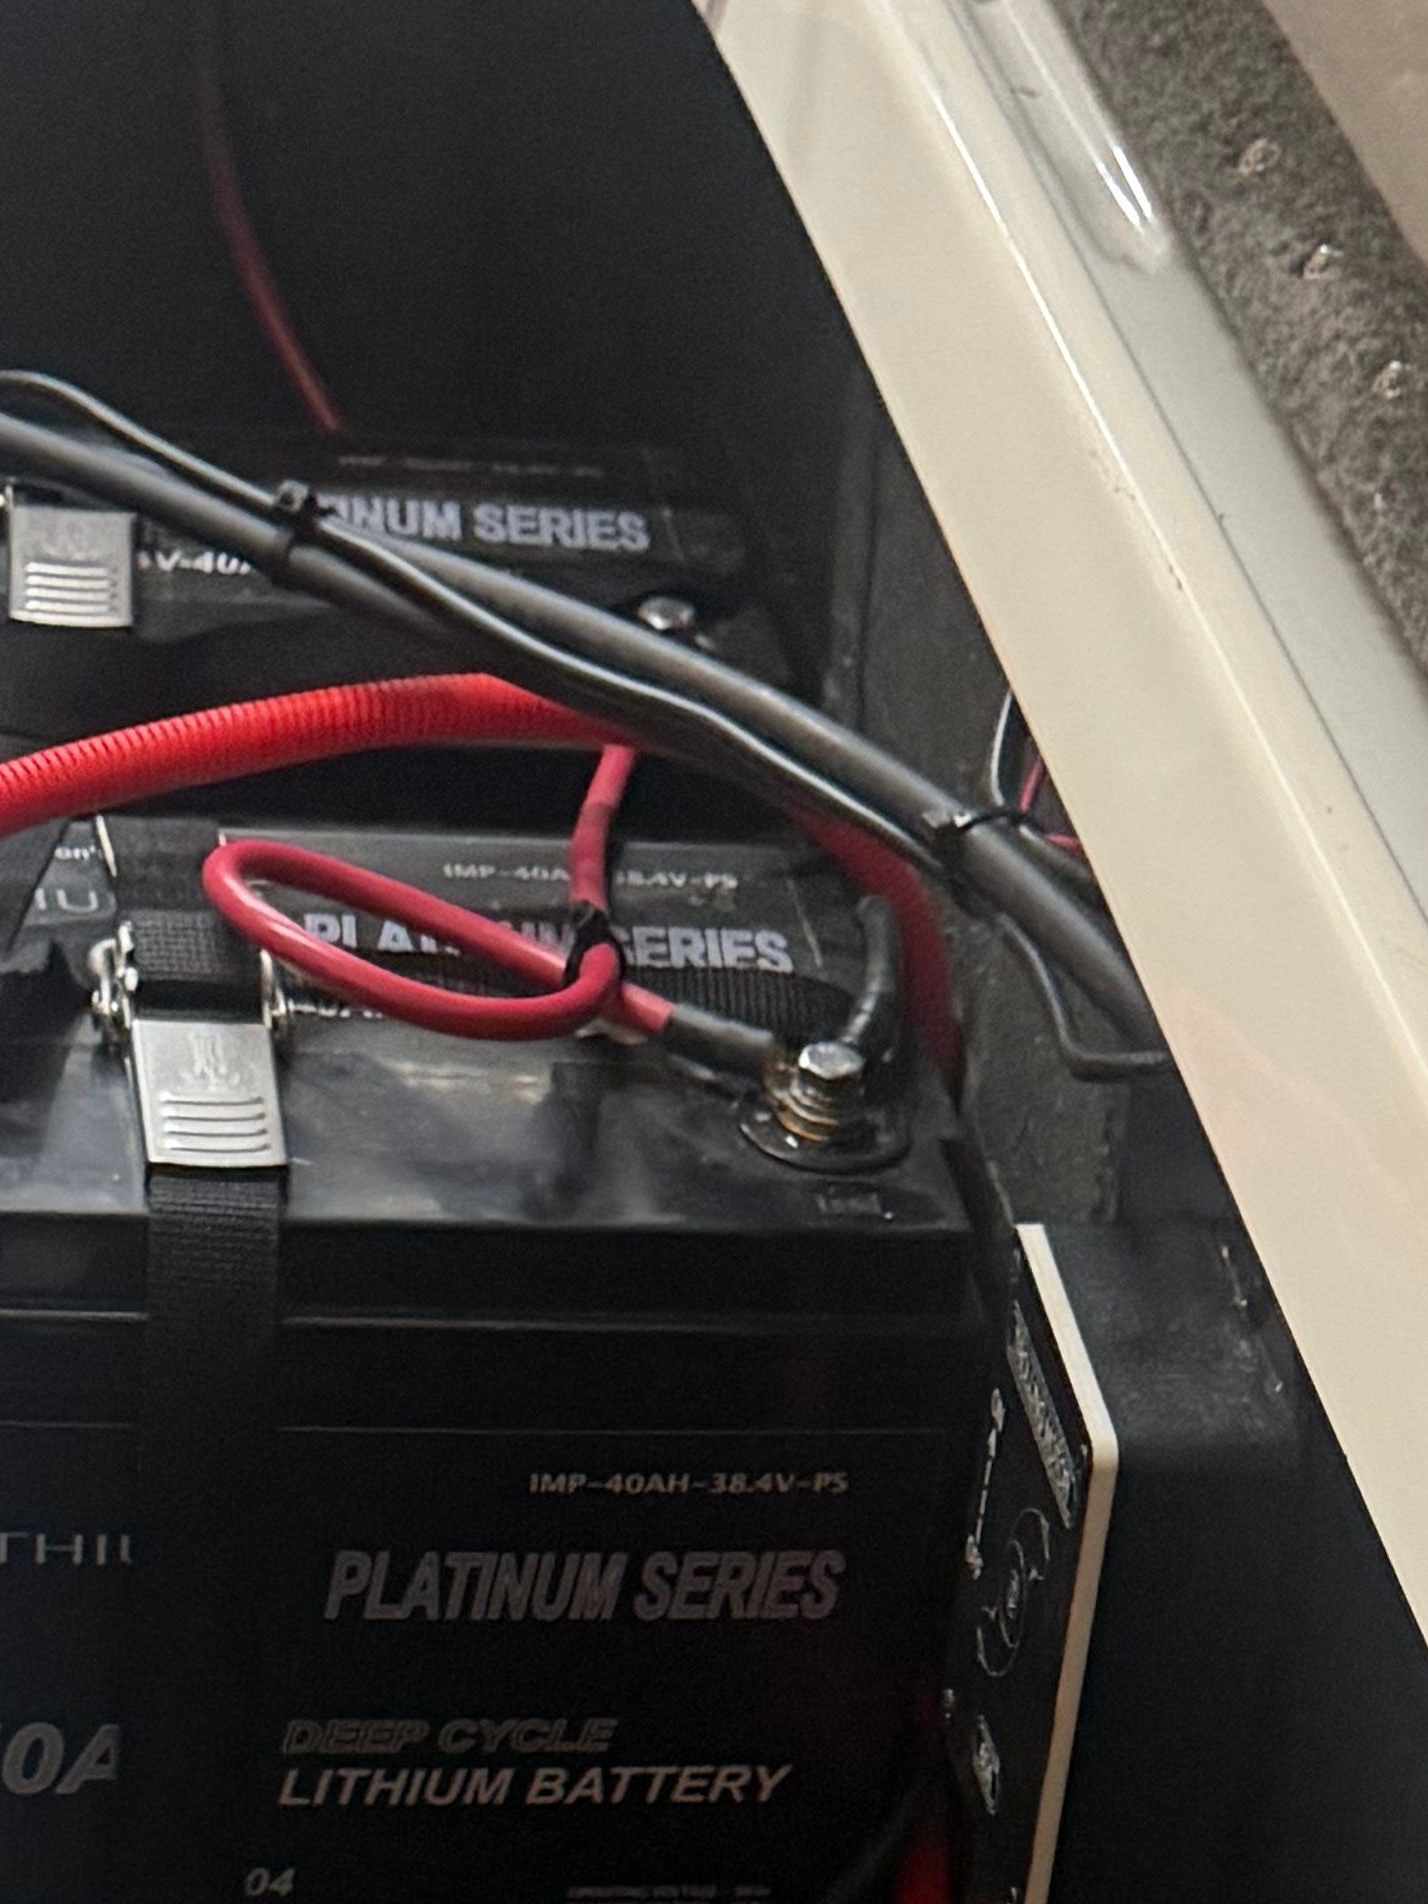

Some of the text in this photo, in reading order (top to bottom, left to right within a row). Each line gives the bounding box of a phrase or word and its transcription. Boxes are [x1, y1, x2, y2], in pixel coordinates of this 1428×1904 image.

[317, 494, 651, 552] INUM SERIES
[528, 1471, 850, 1497] IMP-40AH-38.4V-PS
[323, 1549, 848, 1621] PLATINUM SERIES
[281, 1717, 619, 1755] DEEP CYCLE
[278, 1763, 794, 1807] LITHIUM BATTERY
